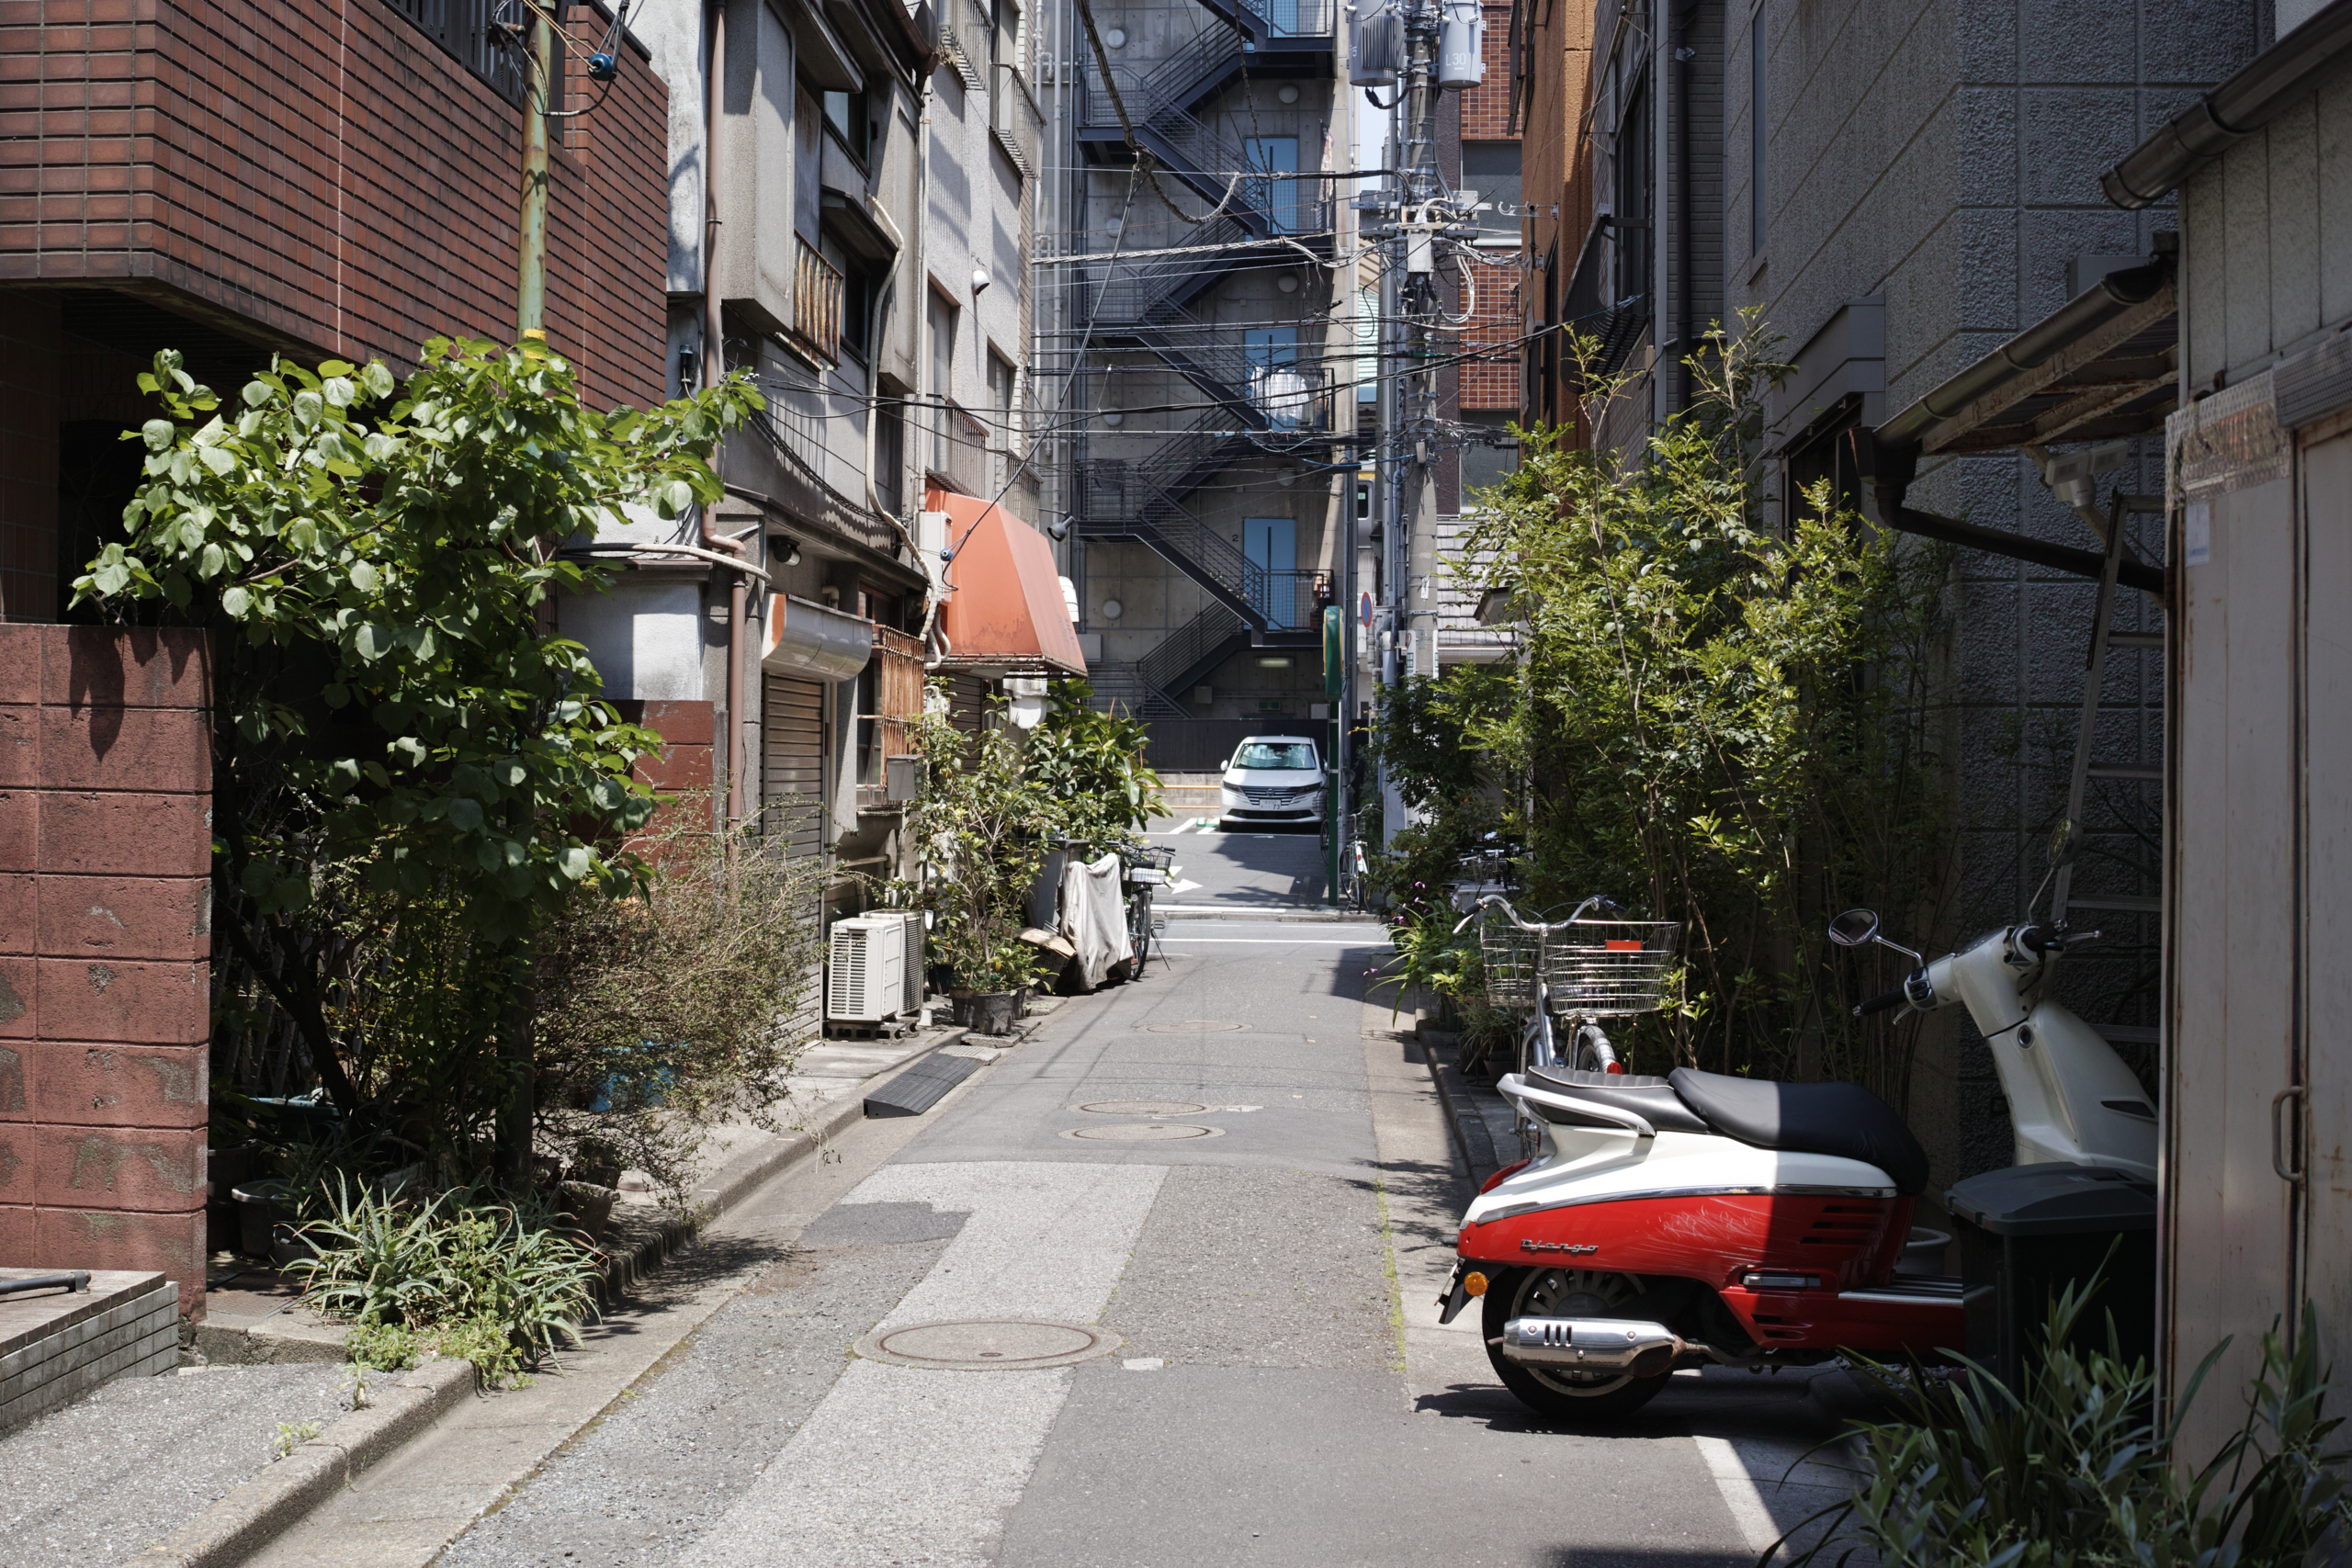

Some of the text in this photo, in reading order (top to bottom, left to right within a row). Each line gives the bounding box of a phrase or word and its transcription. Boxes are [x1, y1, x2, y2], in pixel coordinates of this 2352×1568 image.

[1446, 53, 1466, 66] L30
[1232, 534, 1239, 542] 2
[1521, 1238, 1599, 1253] Django
